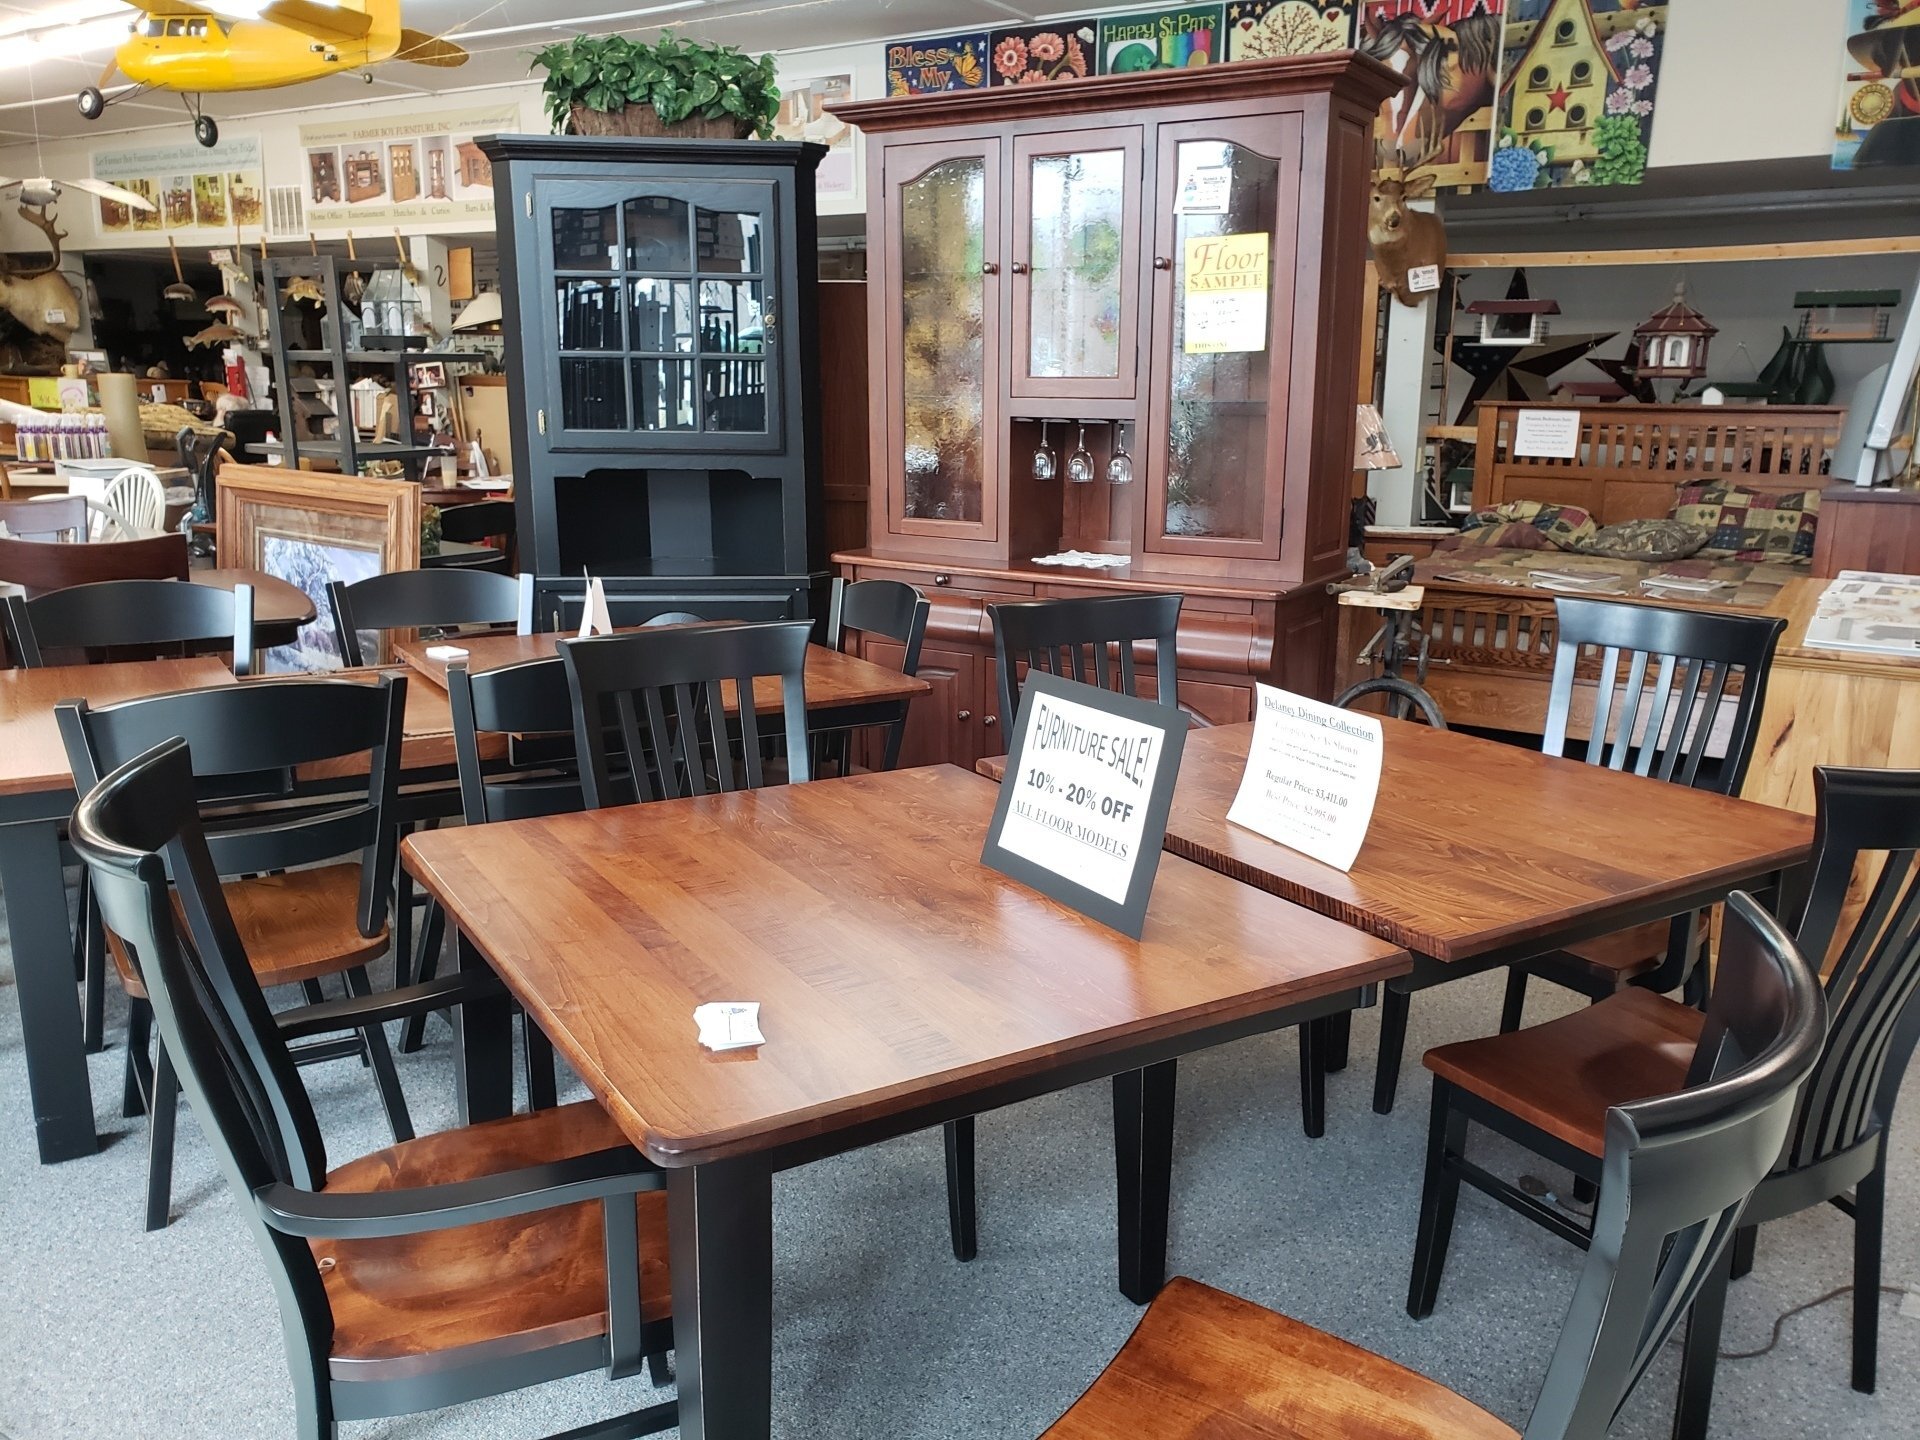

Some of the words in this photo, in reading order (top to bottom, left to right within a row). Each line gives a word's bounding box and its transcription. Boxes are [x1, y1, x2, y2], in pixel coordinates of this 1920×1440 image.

[889, 46, 950, 69] Bless
[918, 66, 952, 92] My
[1191, 243, 1264, 277] Floor
[1190, 274, 1263, 289] SAMPLE
[1264, 696, 1295, 717] Delaney
[1298, 706, 1327, 728] Dining
[1329, 717, 1374, 741] Collection
[1033, 703, 1108, 762] FURNITURE
[1107, 736, 1153, 789] SALE!
[1027, 768, 1056, 794] 10%
[1065, 783, 1097, 811] 20%
[1101, 796, 1134, 823] OFF
[1265, 769, 1292, 787] Regular
[1293, 779, 1314, 796] Price:
[1315, 788, 1348, 808] $3,411.00
[1012, 799, 1034, 819] ALL
[1036, 808, 1073, 836] FLOOR
[1075, 825, 1129, 858] MODELS
